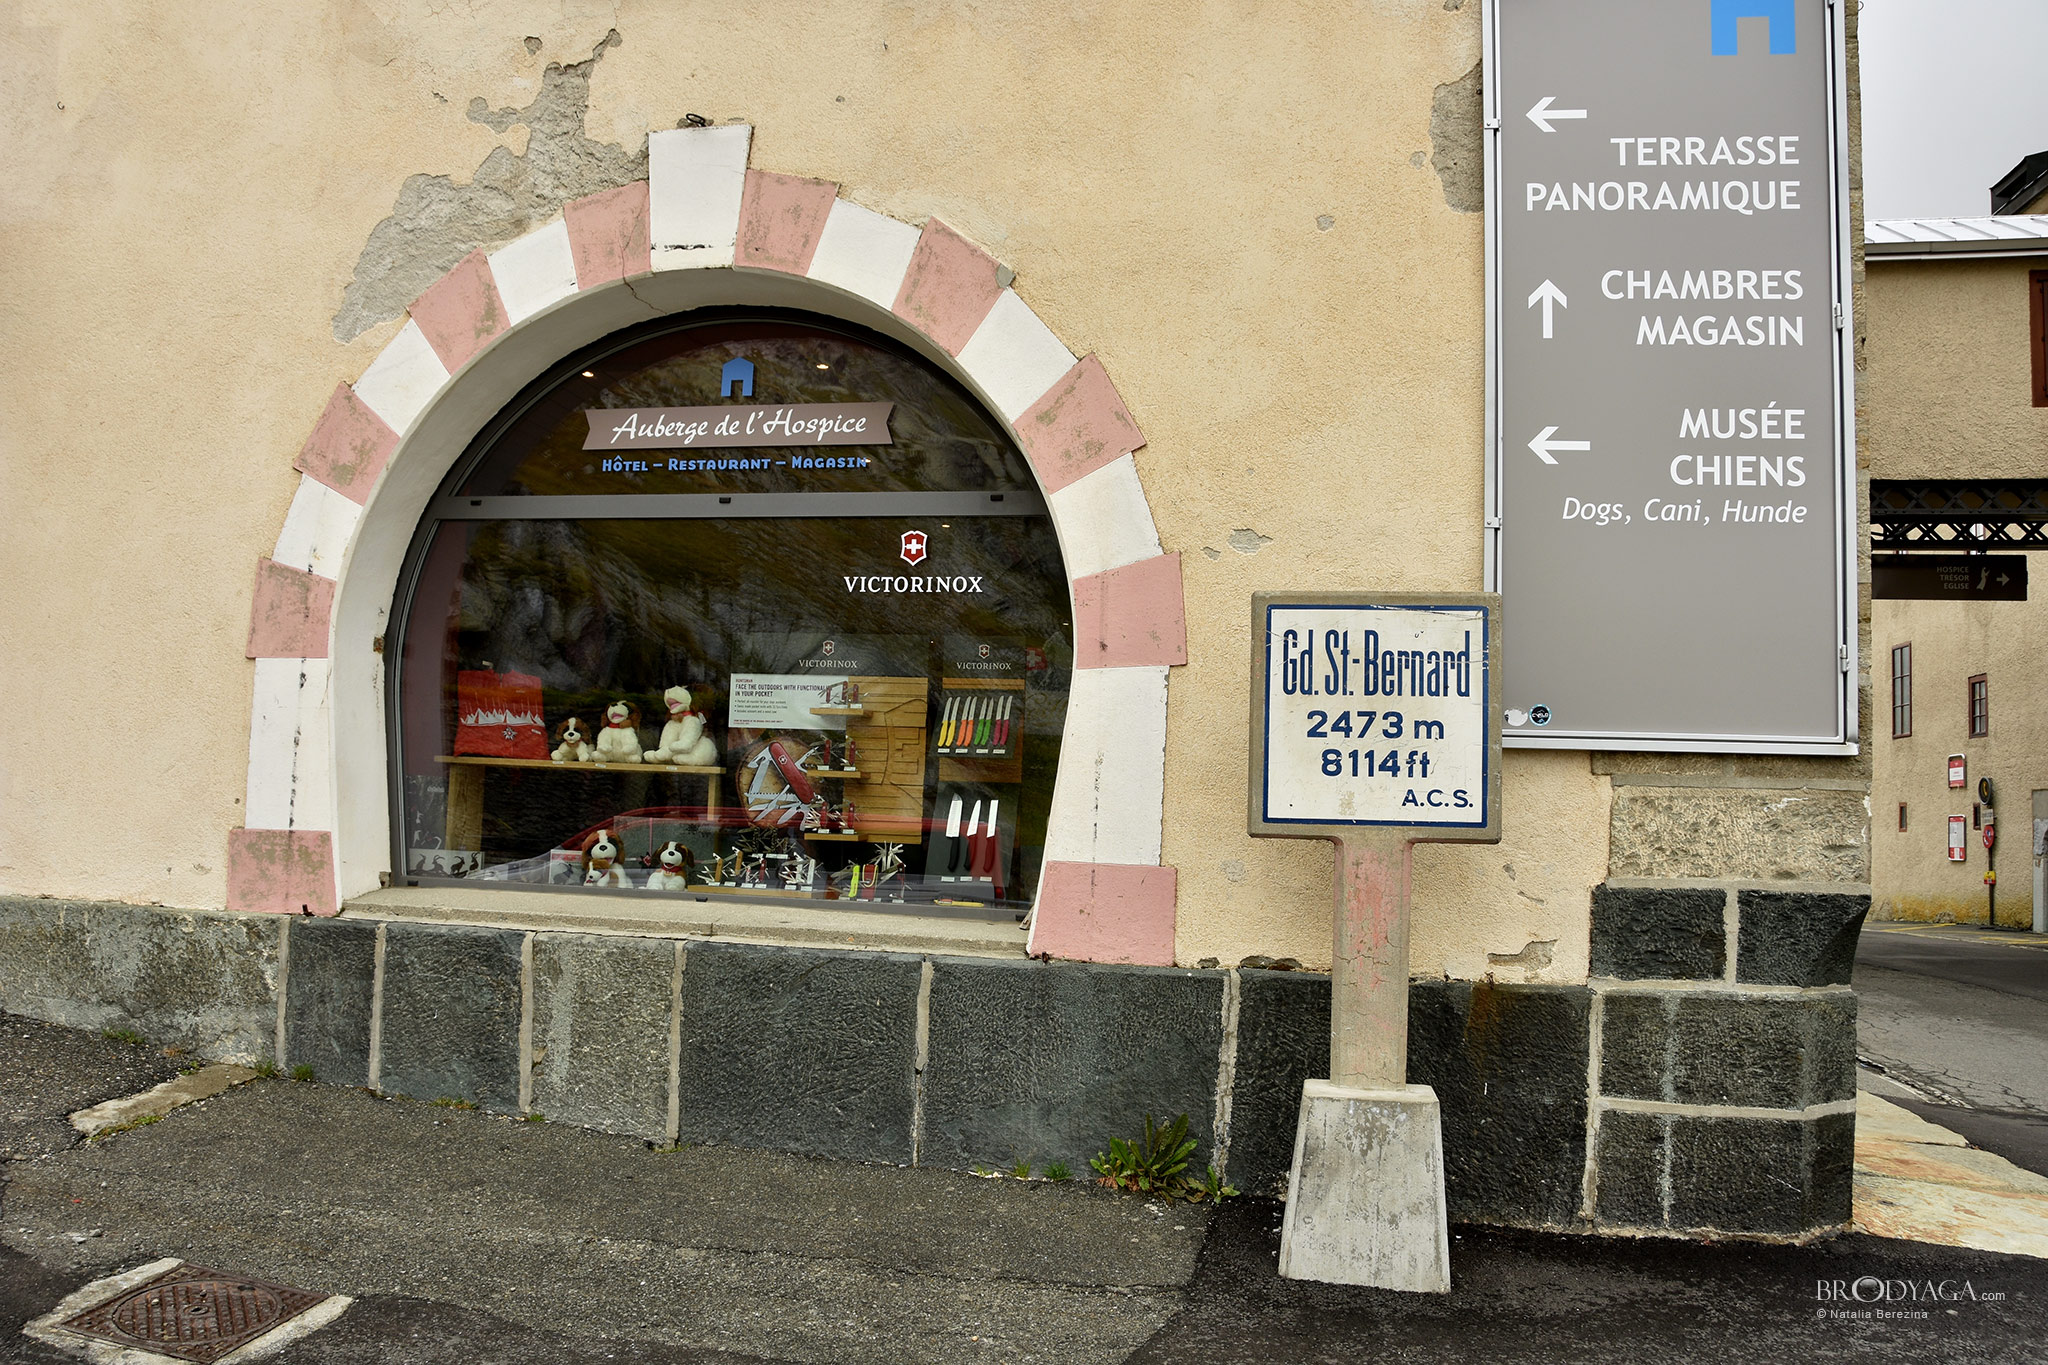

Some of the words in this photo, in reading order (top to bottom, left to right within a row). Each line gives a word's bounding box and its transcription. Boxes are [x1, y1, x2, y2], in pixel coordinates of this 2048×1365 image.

[1610, 136, 1800, 166] TERRASSE
[1526, 180, 1801, 215] PANORAMIQUE
[1600, 269, 1804, 300] CHAMBRES
[1636, 315, 1804, 346] MAGASIN
[610, 412, 708, 445] Auberge
[713, 413, 740, 437] de
[745, 408, 867, 442] l'Hospice
[1679, 401, 1806, 440] MUSÉE
[668, 457, 771, 472] RESTAURANT
[1669, 455, 1806, 487] CHIENS
[1562, 497, 1632, 526] Dogs,
[1643, 498, 1711, 526] Cani,
[1722, 499, 1807, 523] Hunde
[844, 576, 983, 594] VICTORINOX
[1940, 573, 1970, 581] TRÉSOR
[798, 659, 858, 669] VICTORINOX
[956, 661, 1012, 671] VICTORINOX
[1282, 629, 1319, 696] Gd.
[1306, 710, 1404, 739] 2473
[1413, 719, 1445, 740] m
[1321, 749, 1401, 777] 8114
[1405, 751, 1430, 778] ft
[1401, 789, 1475, 808] A.C.S.
